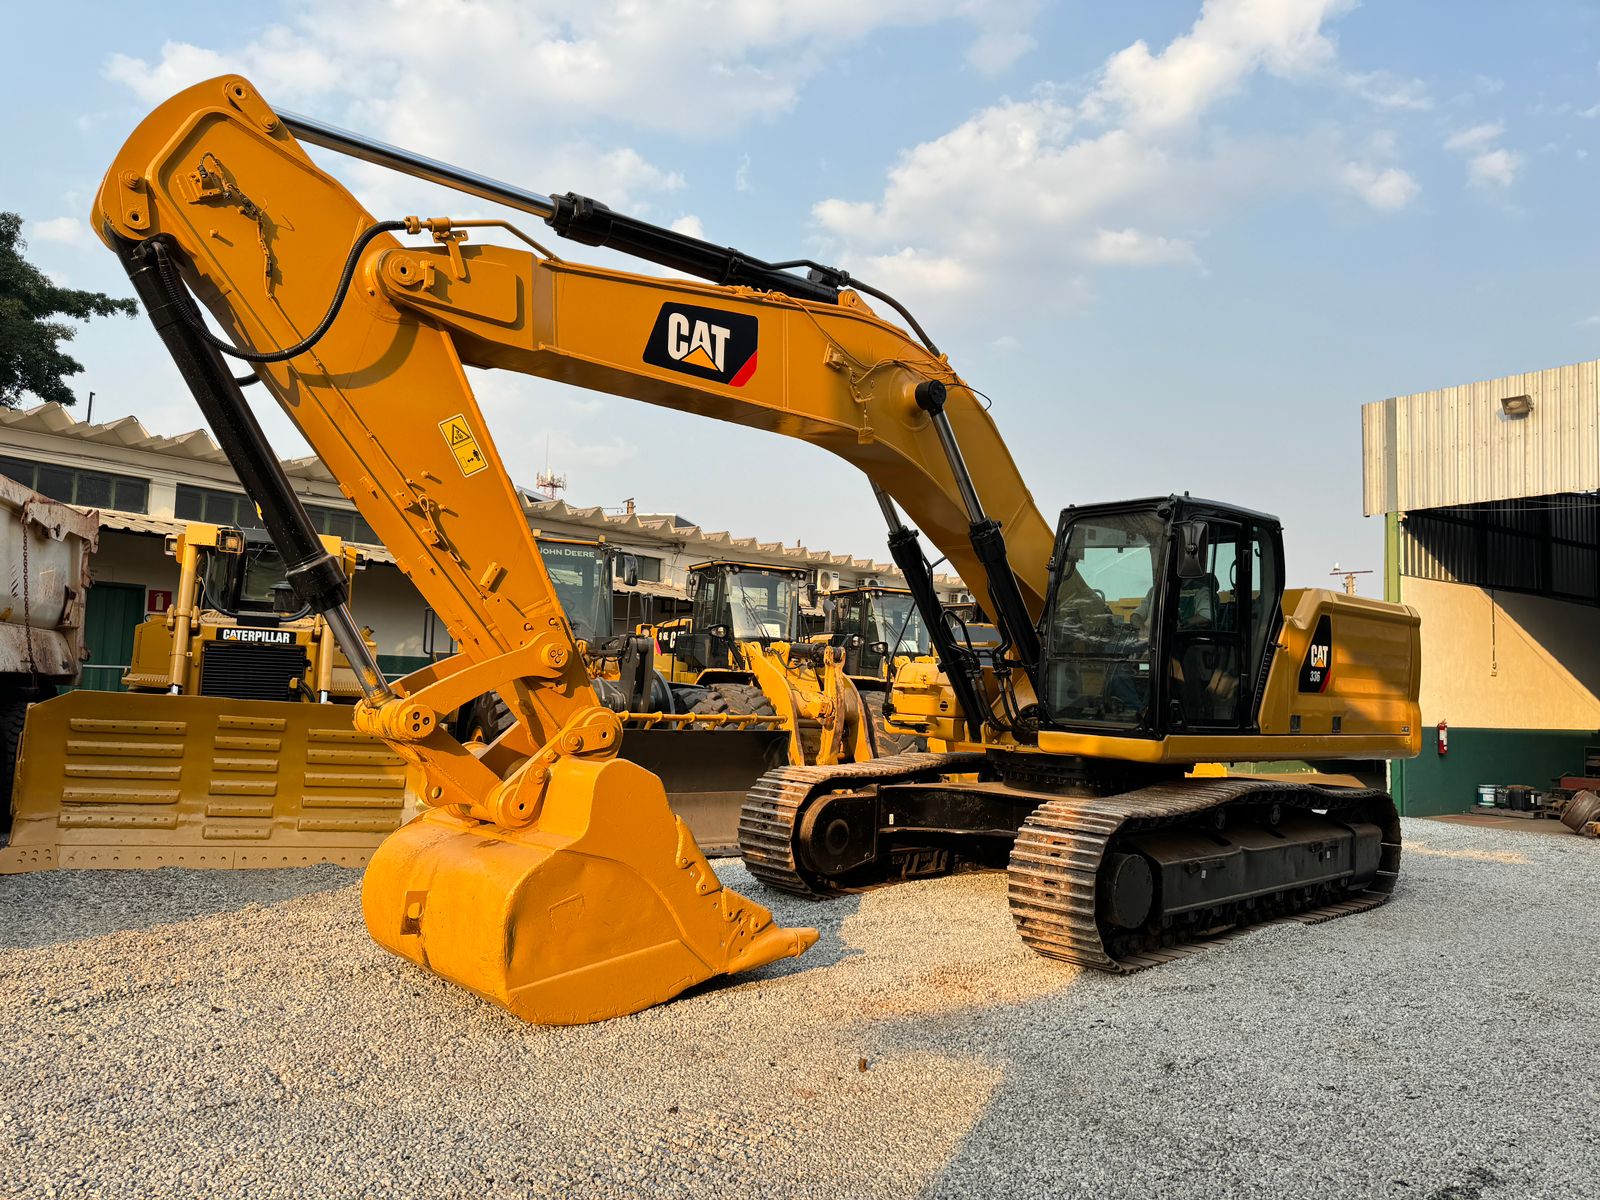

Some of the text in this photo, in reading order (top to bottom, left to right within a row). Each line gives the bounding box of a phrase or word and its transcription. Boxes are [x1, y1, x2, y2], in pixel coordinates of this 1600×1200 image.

[667, 312, 731, 373] CAT
[540, 547, 563, 556] JOHN
[222, 628, 291, 644] CATERPILLAR
[1310, 644, 1329, 668] CAT
[1309, 670, 1321, 682] 336
